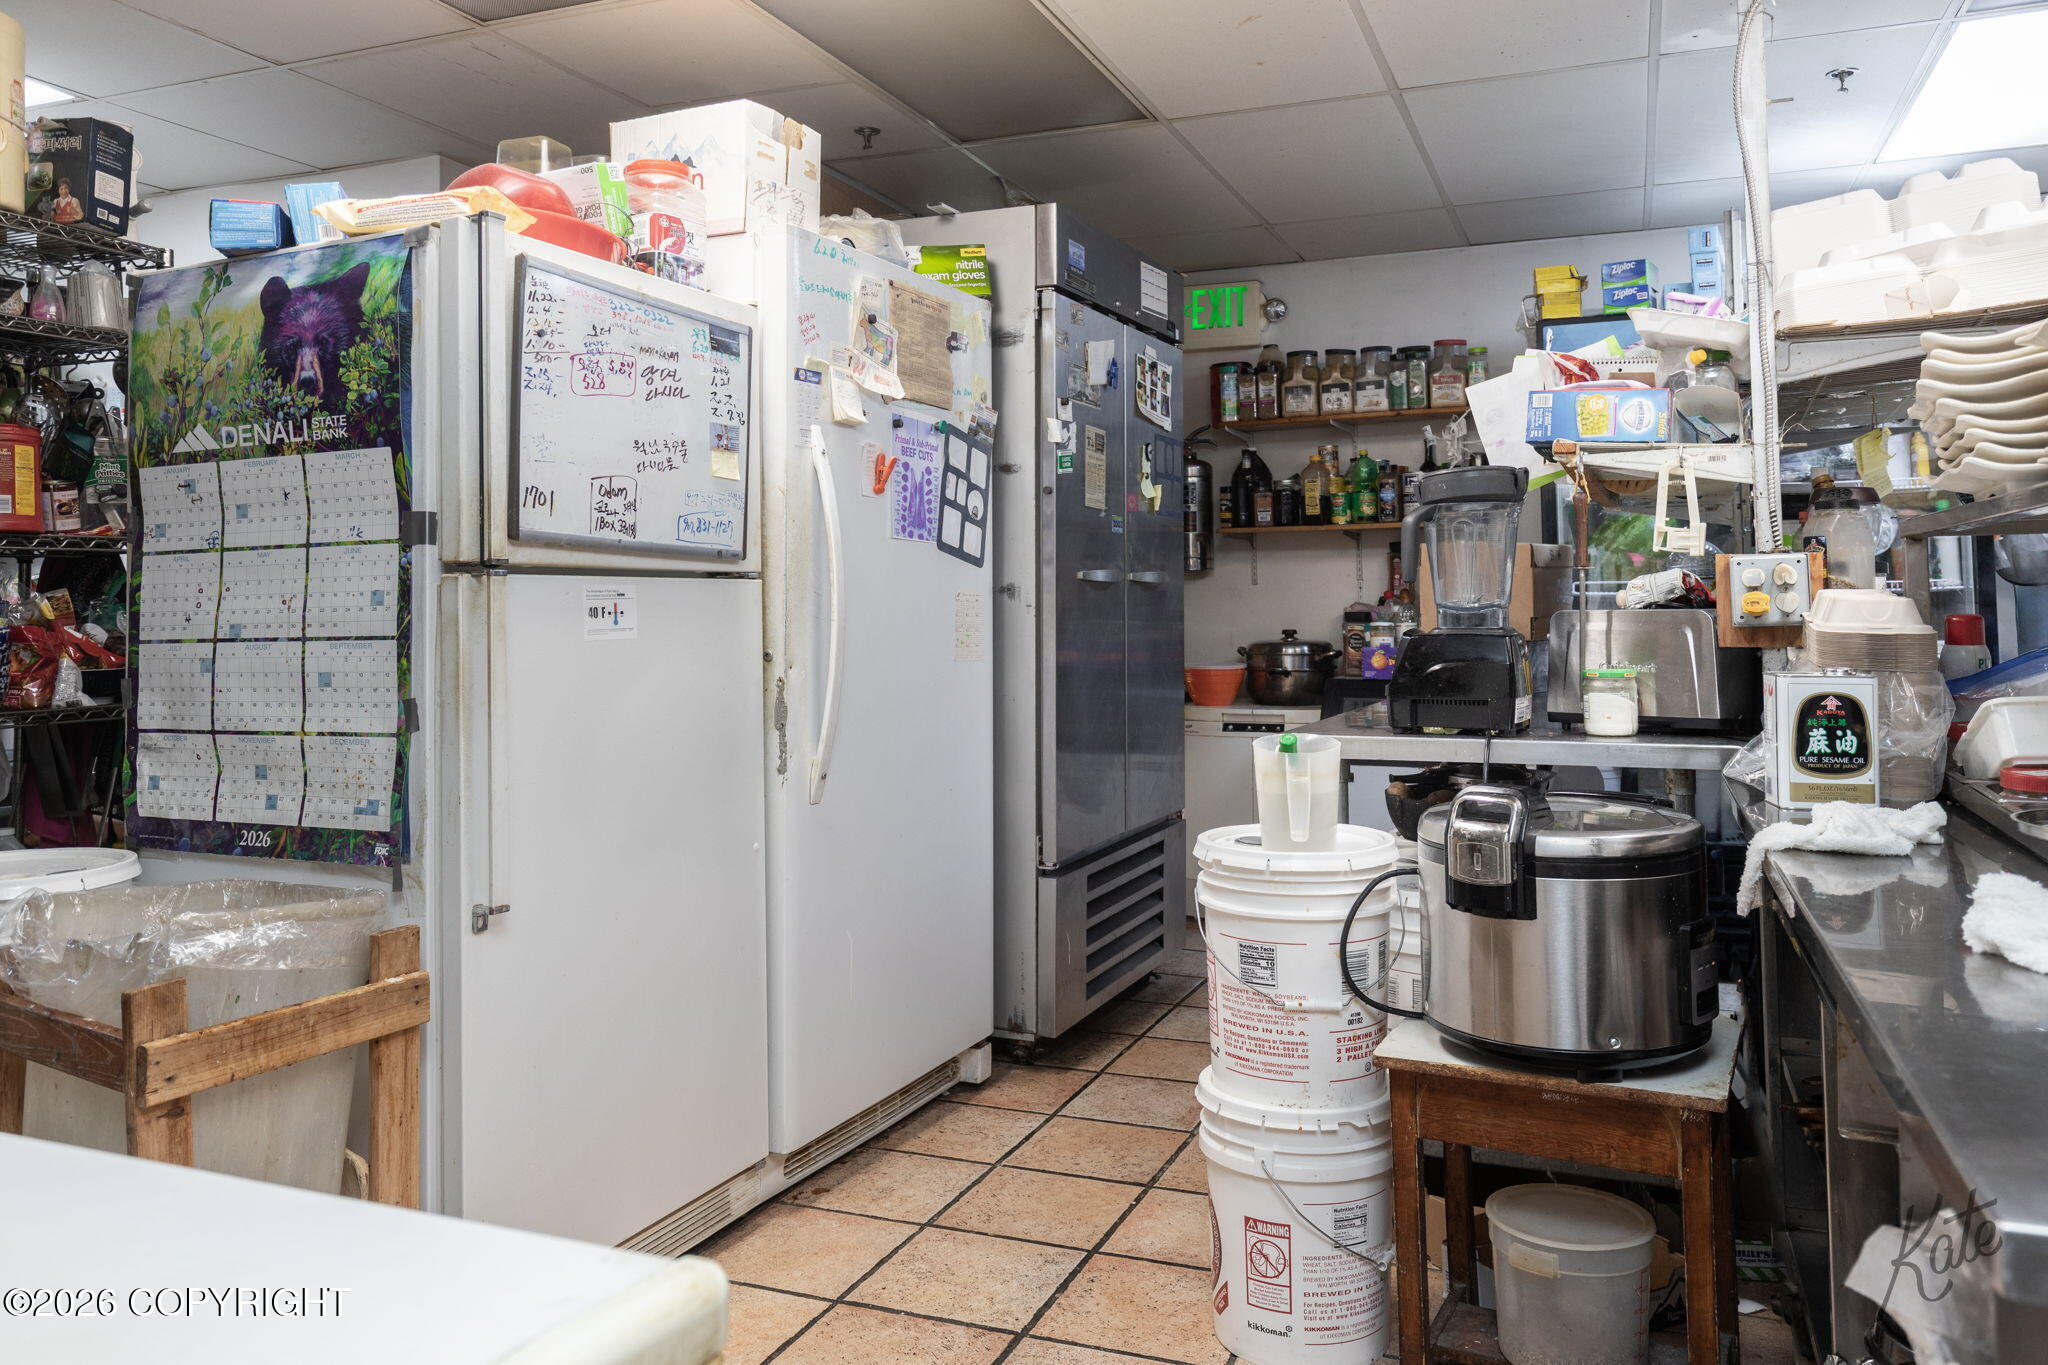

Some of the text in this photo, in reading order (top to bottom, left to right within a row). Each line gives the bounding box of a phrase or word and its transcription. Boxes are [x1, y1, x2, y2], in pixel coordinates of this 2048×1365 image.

[955, 259, 984, 269] nitrile
[1611, 261, 1637, 275] Ziploc
[952, 270, 986, 282] gloves
[1612, 287, 1638, 301] Ziploc
[1190, 286, 1248, 330] EXIT
[311, 415, 348, 429] STATE
[1657, 412, 1667, 440] Slider
[220, 418, 310, 449] DENALI
[312, 428, 349, 441] BANK
[894, 434, 912, 447] Primal
[334, 453, 362, 461] MARCH
[901, 445, 934, 463] BEEF CUTS
[99, 462, 121, 470] Mint
[243, 459, 278, 468] FEBRUARY
[95, 469, 126, 478] Patties
[163, 466, 192, 475] JANUARY
[256, 551, 271, 559] MAY
[343, 547, 363, 555] JUNE
[172, 555, 190, 563] APRIL
[244, 643, 273, 651] AUGUST
[329, 642, 374, 650] SEPTEMBER
[237, 737, 277, 745] NOVEMBER
[328, 738, 371, 746] DECEMBER
[1799, 755, 1819, 763] PURE
[1822, 756, 1850, 764] SESAME
[239, 830, 272, 848] 2026
[374, 846, 389, 856] FDIC
[1239, 943, 1275, 953] Nutrition Facts
[1243, 1009, 1273, 1019] KIKKOMAN
[1274, 1014, 1297, 1022] FOODS,
[1347, 1017, 1364, 1026] 00182
[1222, 1017, 1259, 1032] BREWED
[1276, 1029, 1310, 1037] U.S.A.
[1279, 1039, 1309, 1047] Comments:
[1336, 1033, 1373, 1044] STACKING
[1345, 1045, 1363, 1054] HIGH
[1333, 1206, 1356, 1214] Nutrition
[1256, 1221, 1290, 1238] WARNING
[1303, 1289, 1351, 1298] BREWED
[1354, 1286, 1363, 1294] IN
[1303, 1301, 1313, 1309] For
[1314, 1300, 1338, 1310] Recipes,
[1247, 1319, 1290, 1338] kikkoman
[1303, 1325, 1340, 1333] KIKKOMAN
